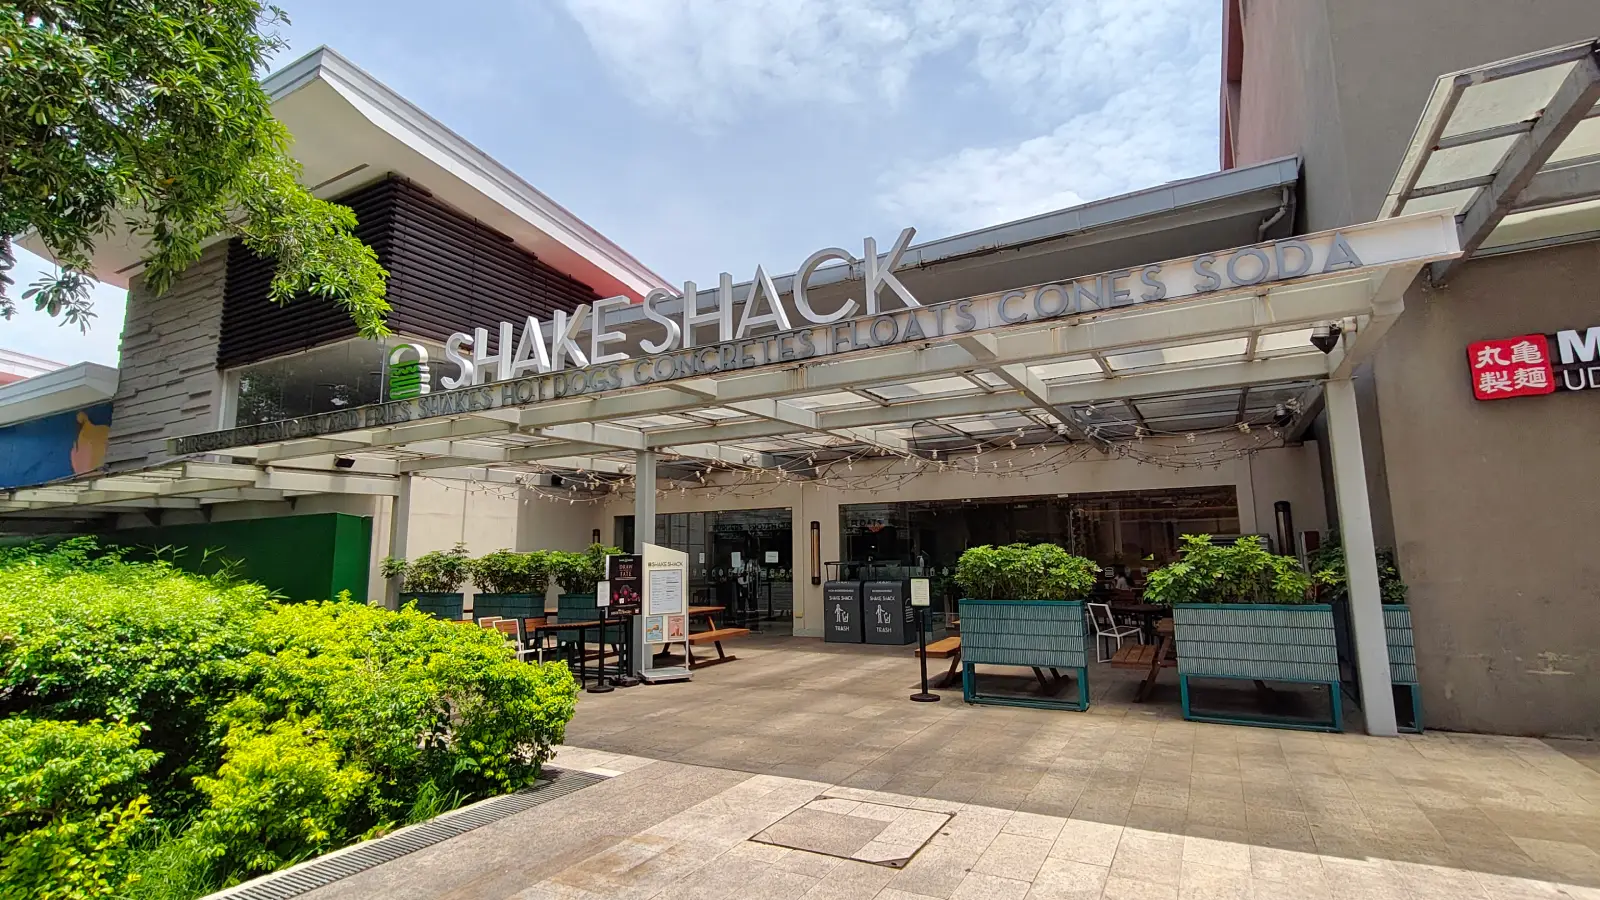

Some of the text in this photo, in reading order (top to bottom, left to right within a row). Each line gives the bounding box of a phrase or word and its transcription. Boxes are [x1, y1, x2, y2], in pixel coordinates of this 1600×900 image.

[365, 401, 412, 427] FRIES
[417, 386, 493, 418] SHAKES
[501, 377, 547, 406] HOT
[553, 364, 623, 398] DOGS
[633, 329, 815, 384] CONCRETES
[831, 300, 977, 353] FLOATS
[998, 265, 1167, 324] CONES
[1195, 232, 1364, 293] SODA
[440, 226, 922, 389] SHAKE SHACK
